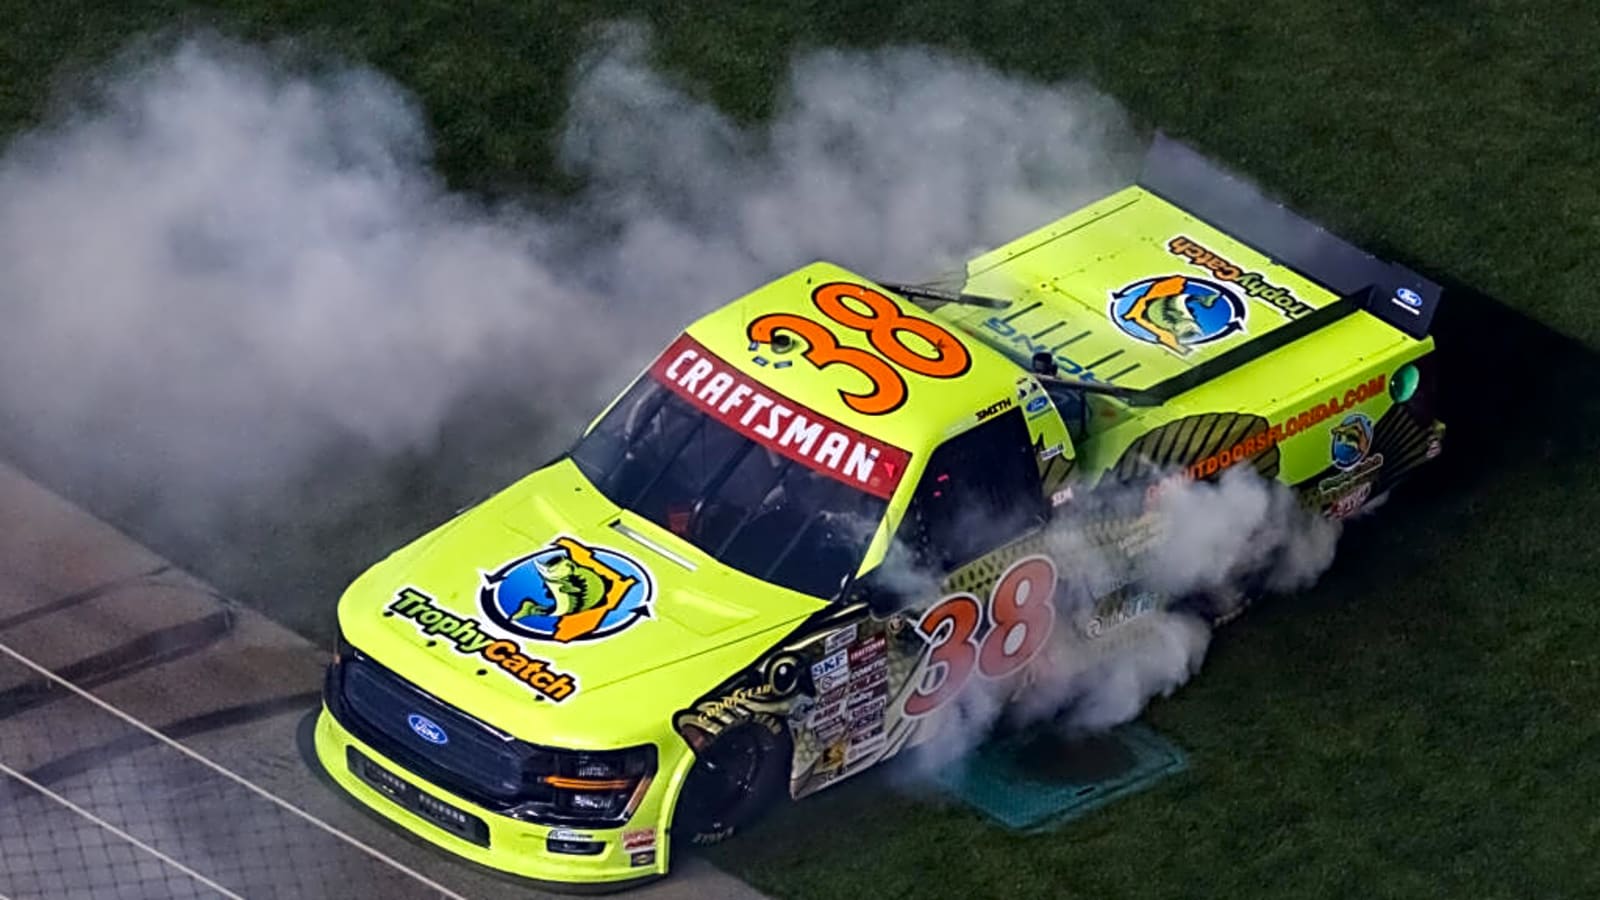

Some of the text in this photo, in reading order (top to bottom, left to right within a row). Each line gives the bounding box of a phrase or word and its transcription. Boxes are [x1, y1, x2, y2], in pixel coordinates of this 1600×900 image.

[1168, 236, 1316, 320] TrophyCatch
[747, 282, 972, 415] 38
[665, 349, 881, 483] CRAFTSMAN
[975, 398, 1012, 421] SMITH
[388, 588, 578, 702] TrophyCatch
[812, 651, 846, 674] SKF
[903, 556, 1057, 718] 38
[411, 717, 443, 742] Ford
